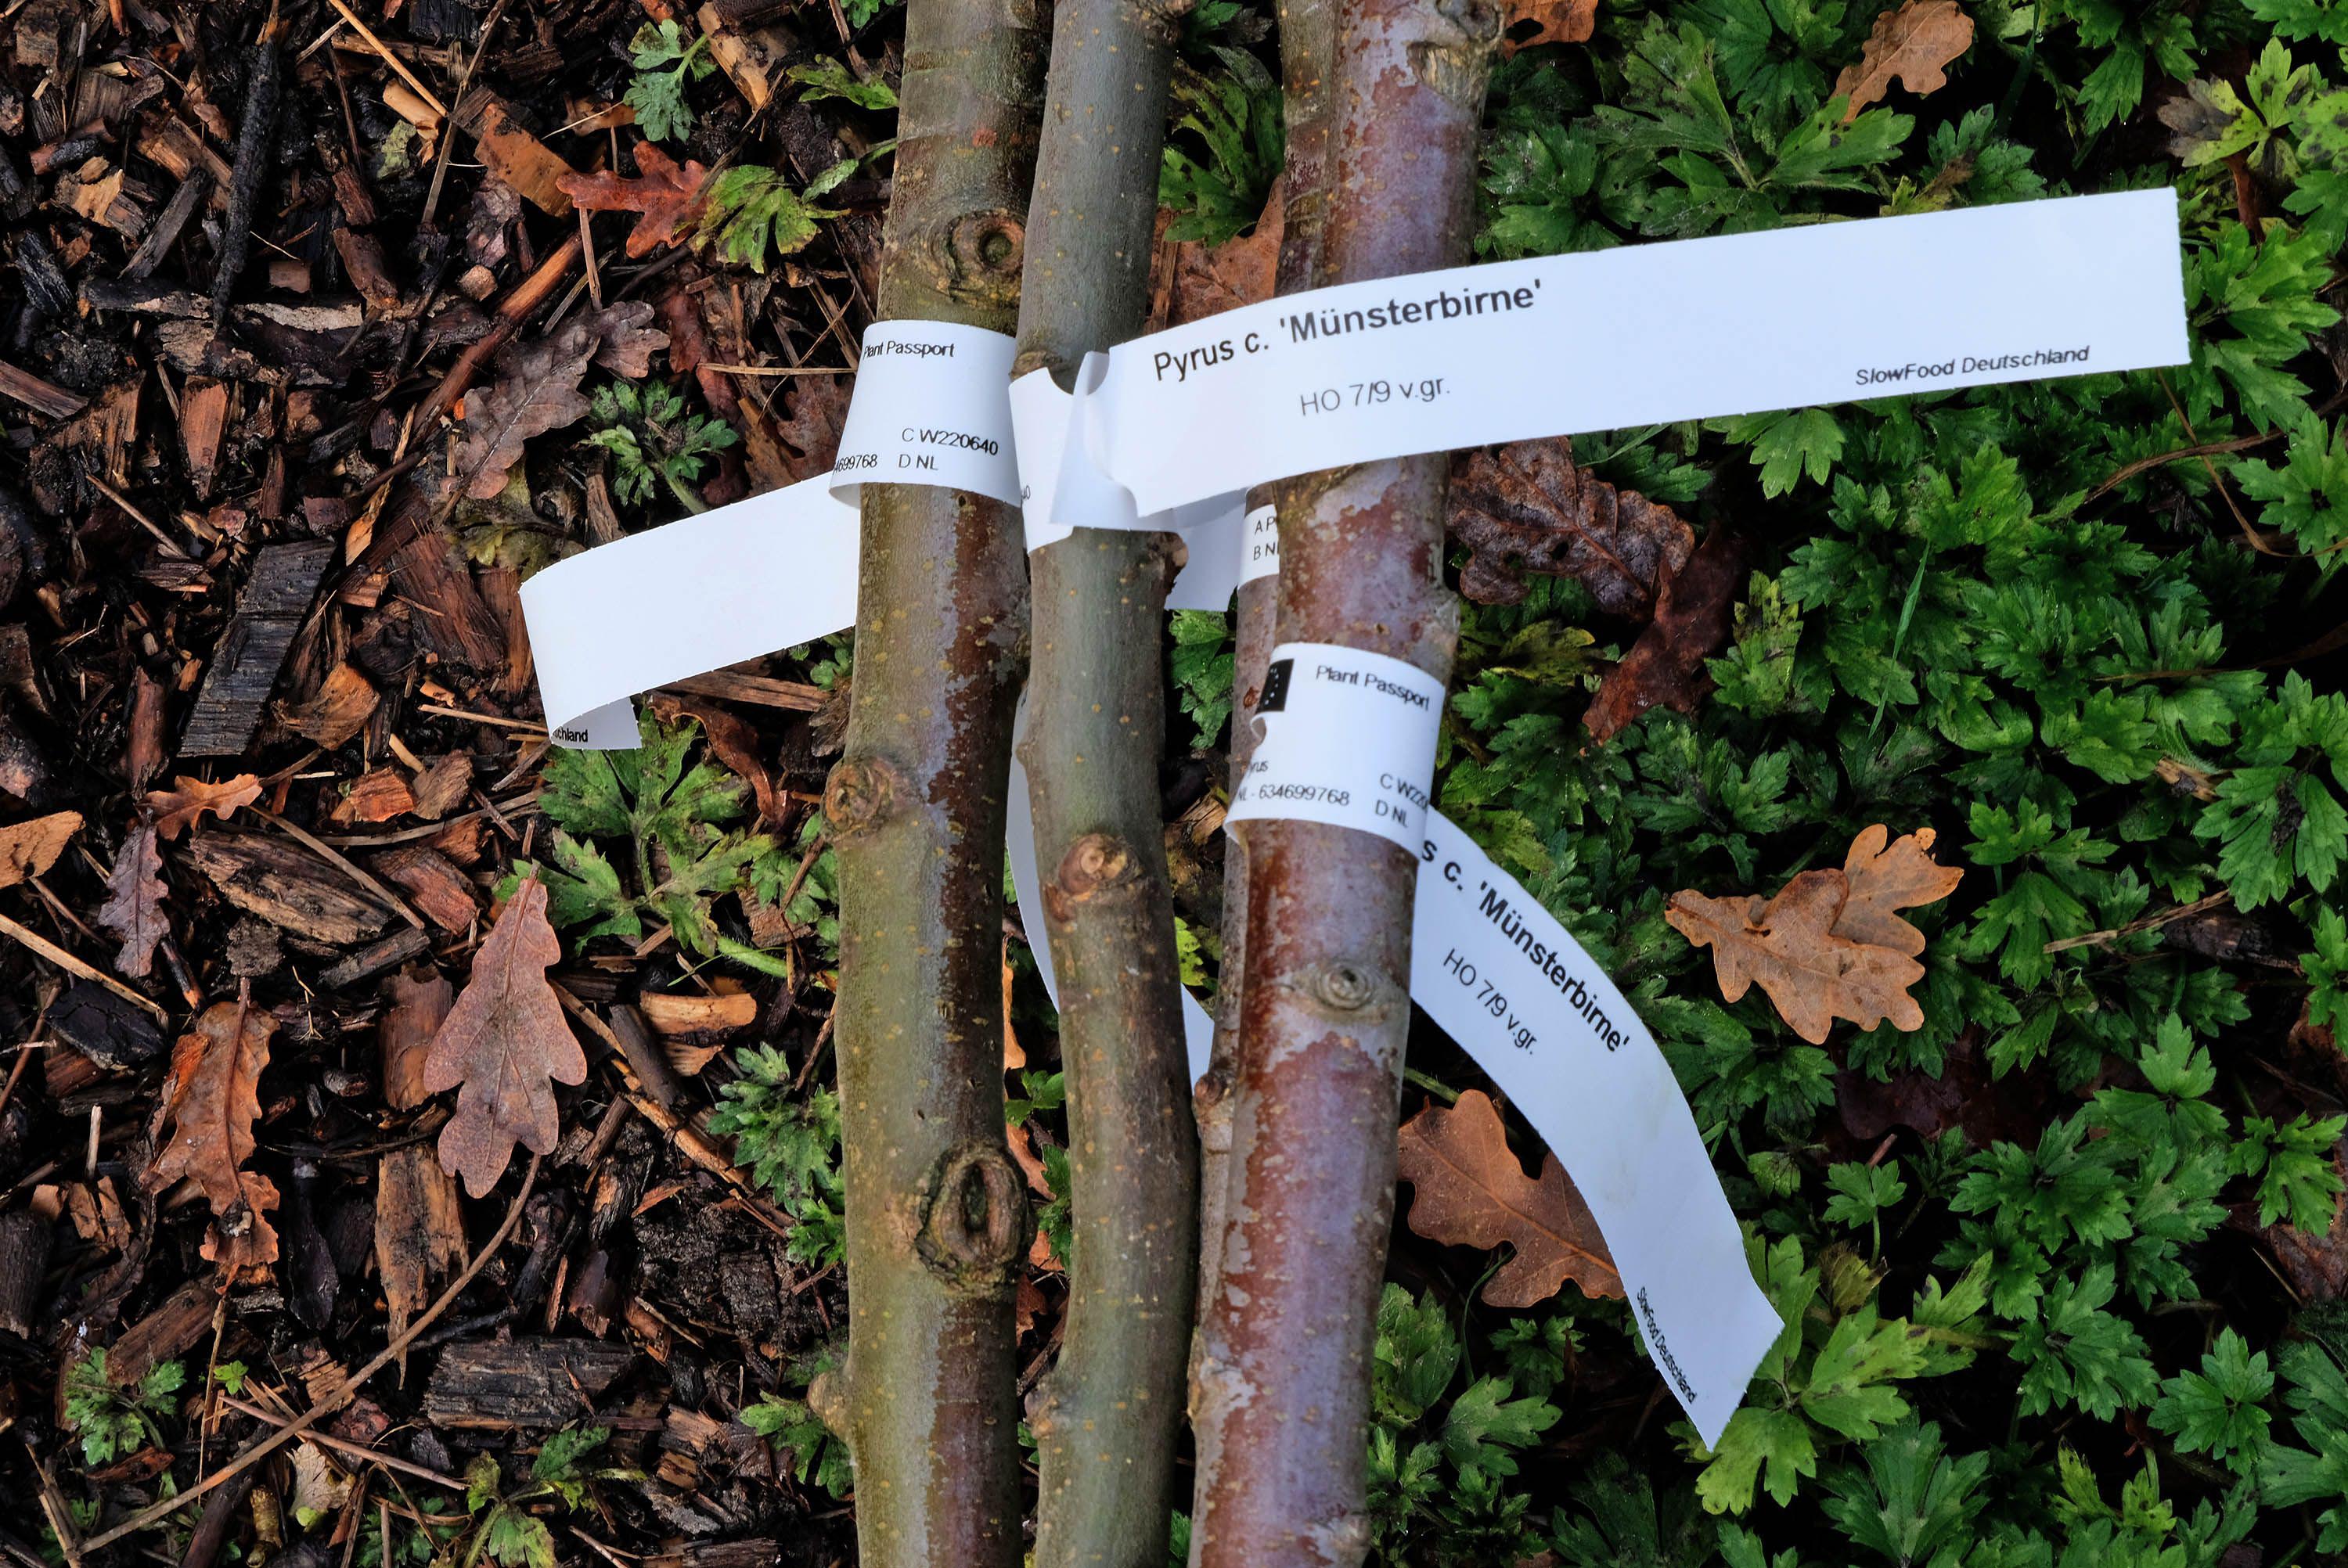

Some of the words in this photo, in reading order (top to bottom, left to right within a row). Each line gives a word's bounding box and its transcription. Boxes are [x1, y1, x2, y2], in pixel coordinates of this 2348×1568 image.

[1154, 338, 1235, 382] Pyrus
[1244, 331, 1269, 354] c.
[1279, 278, 1542, 343] 'Münsterbirne'
[862, 341, 884, 361] Plant
[885, 340, 955, 359] Passport
[1856, 358, 1955, 386] SlowFood
[1961, 345, 2091, 374] Deutschland
[1299, 388, 1341, 416] HO
[1349, 379, 1392, 407] 7/9
[1399, 374, 1451, 401] v.gr.
[902, 427, 914, 443] C
[920, 429, 999, 455] W220640
[898, 454, 912, 469] D
[916, 455, 939, 470] NL
[1254, 519, 1263, 537] A
[1253, 545, 1262, 562] B
[1315, 665, 1361, 685] Plant
[1363, 673, 1431, 711] Passport
[1259, 783, 1350, 807] 634699768
[1379, 772, 1393, 789] C
[1375, 799, 1389, 817] D
[1392, 804, 1409, 829] NL
[1421, 840, 1438, 863] s
[1443, 861, 1463, 892] c.
[1478, 880, 1630, 1052] 'Münsterbirne'
[1442, 948, 1477, 987] HO
[1476, 979, 1508, 1018] 7/9
[1507, 1013, 1538, 1056] v.gr.
[1637, 1286, 1662, 1340] SlowFood
[1655, 1334, 1698, 1405] Deutschland
